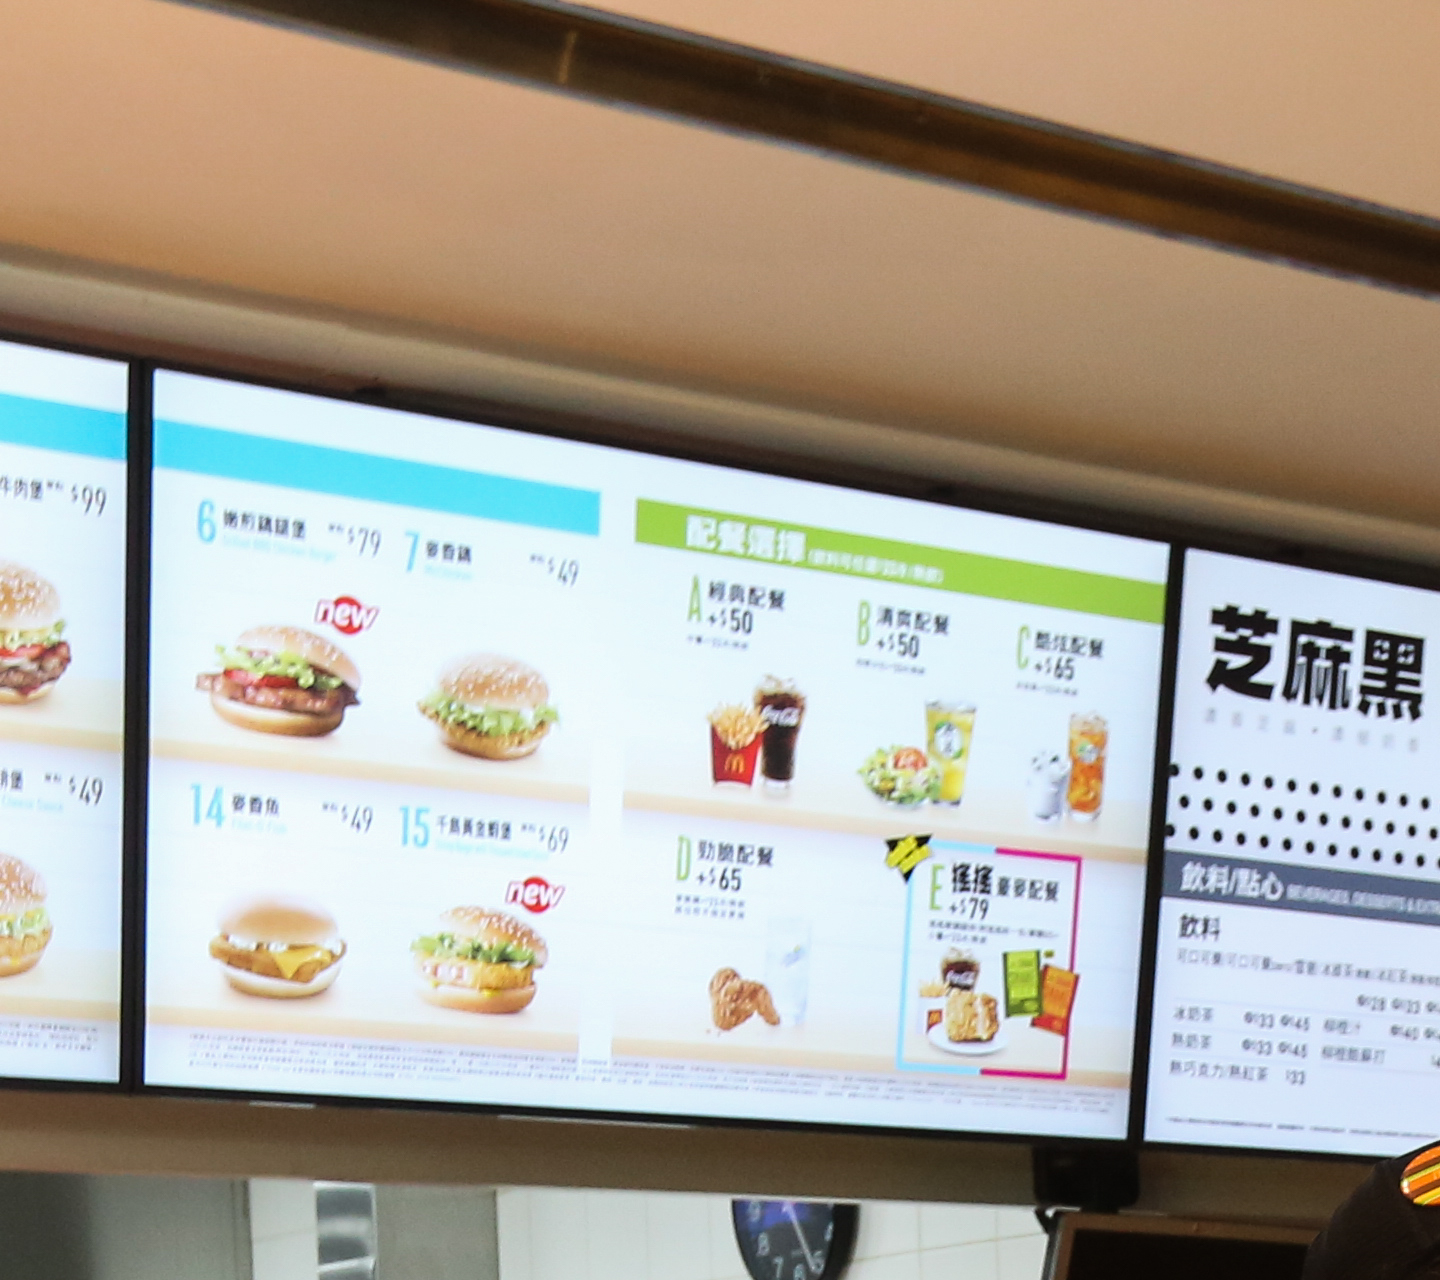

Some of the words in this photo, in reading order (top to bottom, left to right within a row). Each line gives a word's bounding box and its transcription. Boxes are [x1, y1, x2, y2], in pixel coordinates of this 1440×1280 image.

[68, 484, 104, 517] $99
[197, 499, 217, 543] 6
[405, 532, 420, 573] 7
[315, 597, 379, 631] new
[688, 574, 702, 622] A
[858, 600, 871, 646] B
[1017, 625, 1030, 670] C
[1207, 605, 1426, 721] 芝麻黑
[69, 776, 103, 806] $49
[191, 784, 226, 828] 14
[399, 806, 430, 849] 15
[677, 835, 691, 881] D
[505, 878, 565, 909] new
[930, 864, 945, 911] E
[1180, 860, 1284, 902] 飲料/點心
[1178, 913, 1221, 942] 飲料
